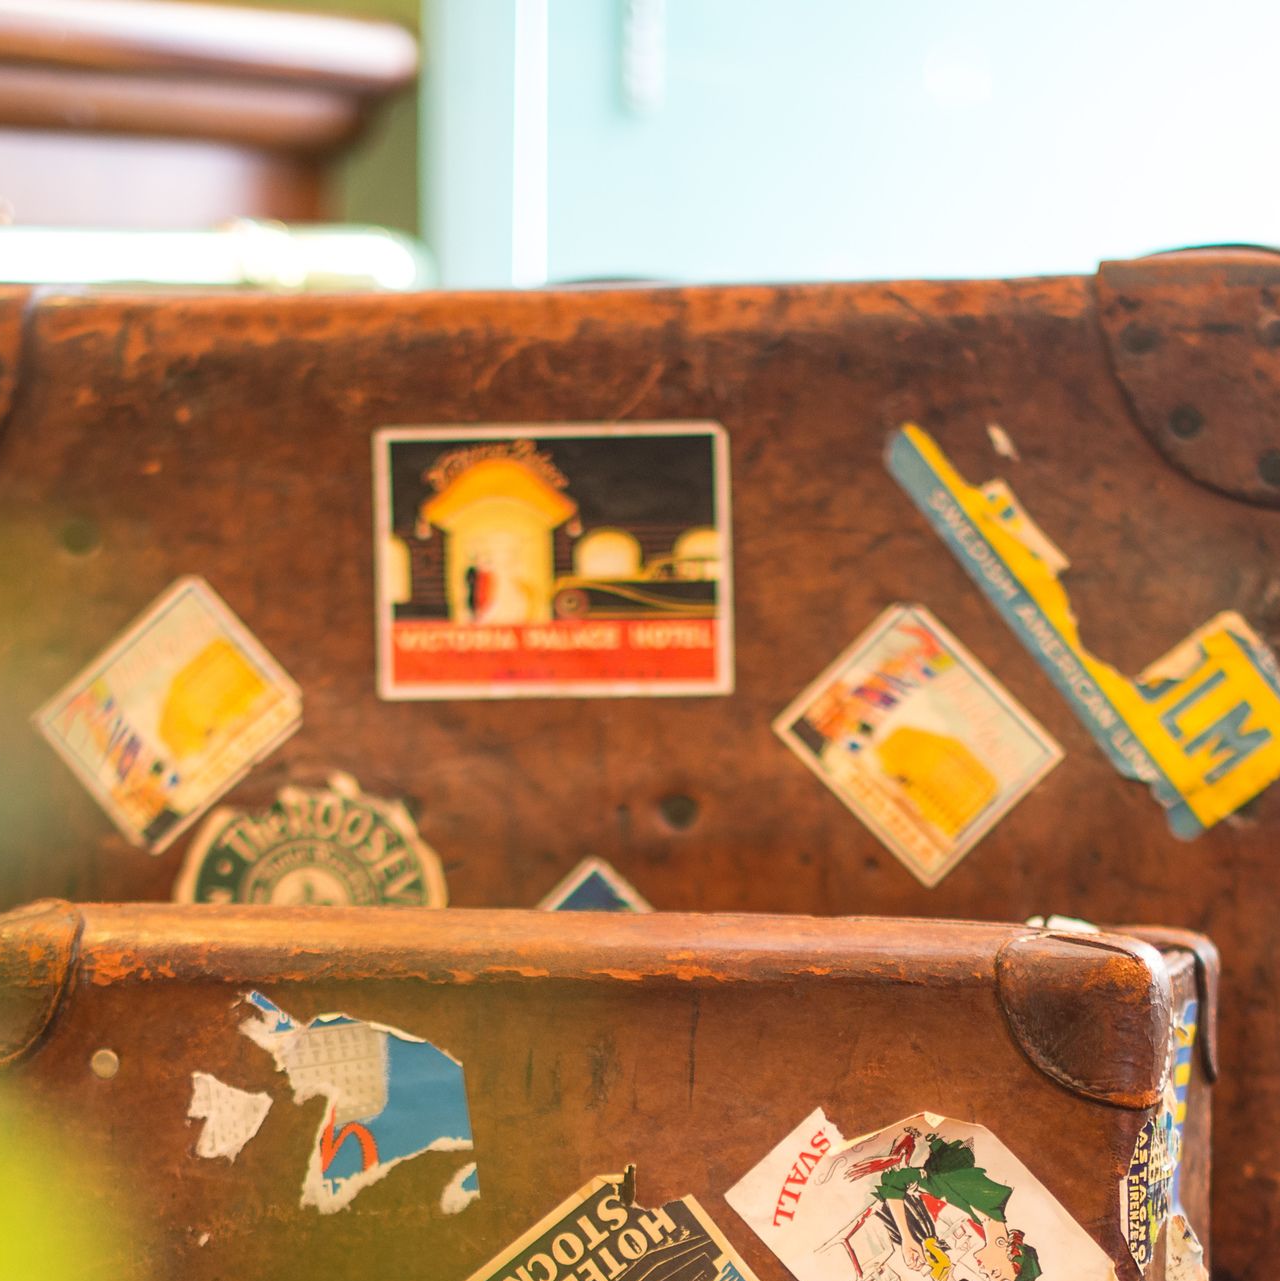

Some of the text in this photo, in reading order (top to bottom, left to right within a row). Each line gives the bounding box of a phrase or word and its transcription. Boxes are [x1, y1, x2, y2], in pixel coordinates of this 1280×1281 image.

[397, 626, 517, 650] VICTORIA
[631, 623, 713, 648] HOTEL
[928, 489, 1019, 601] SWEDISH
[1016, 602, 1115, 731] AMERICAN
[773, 1130, 832, 1227] SVALL
